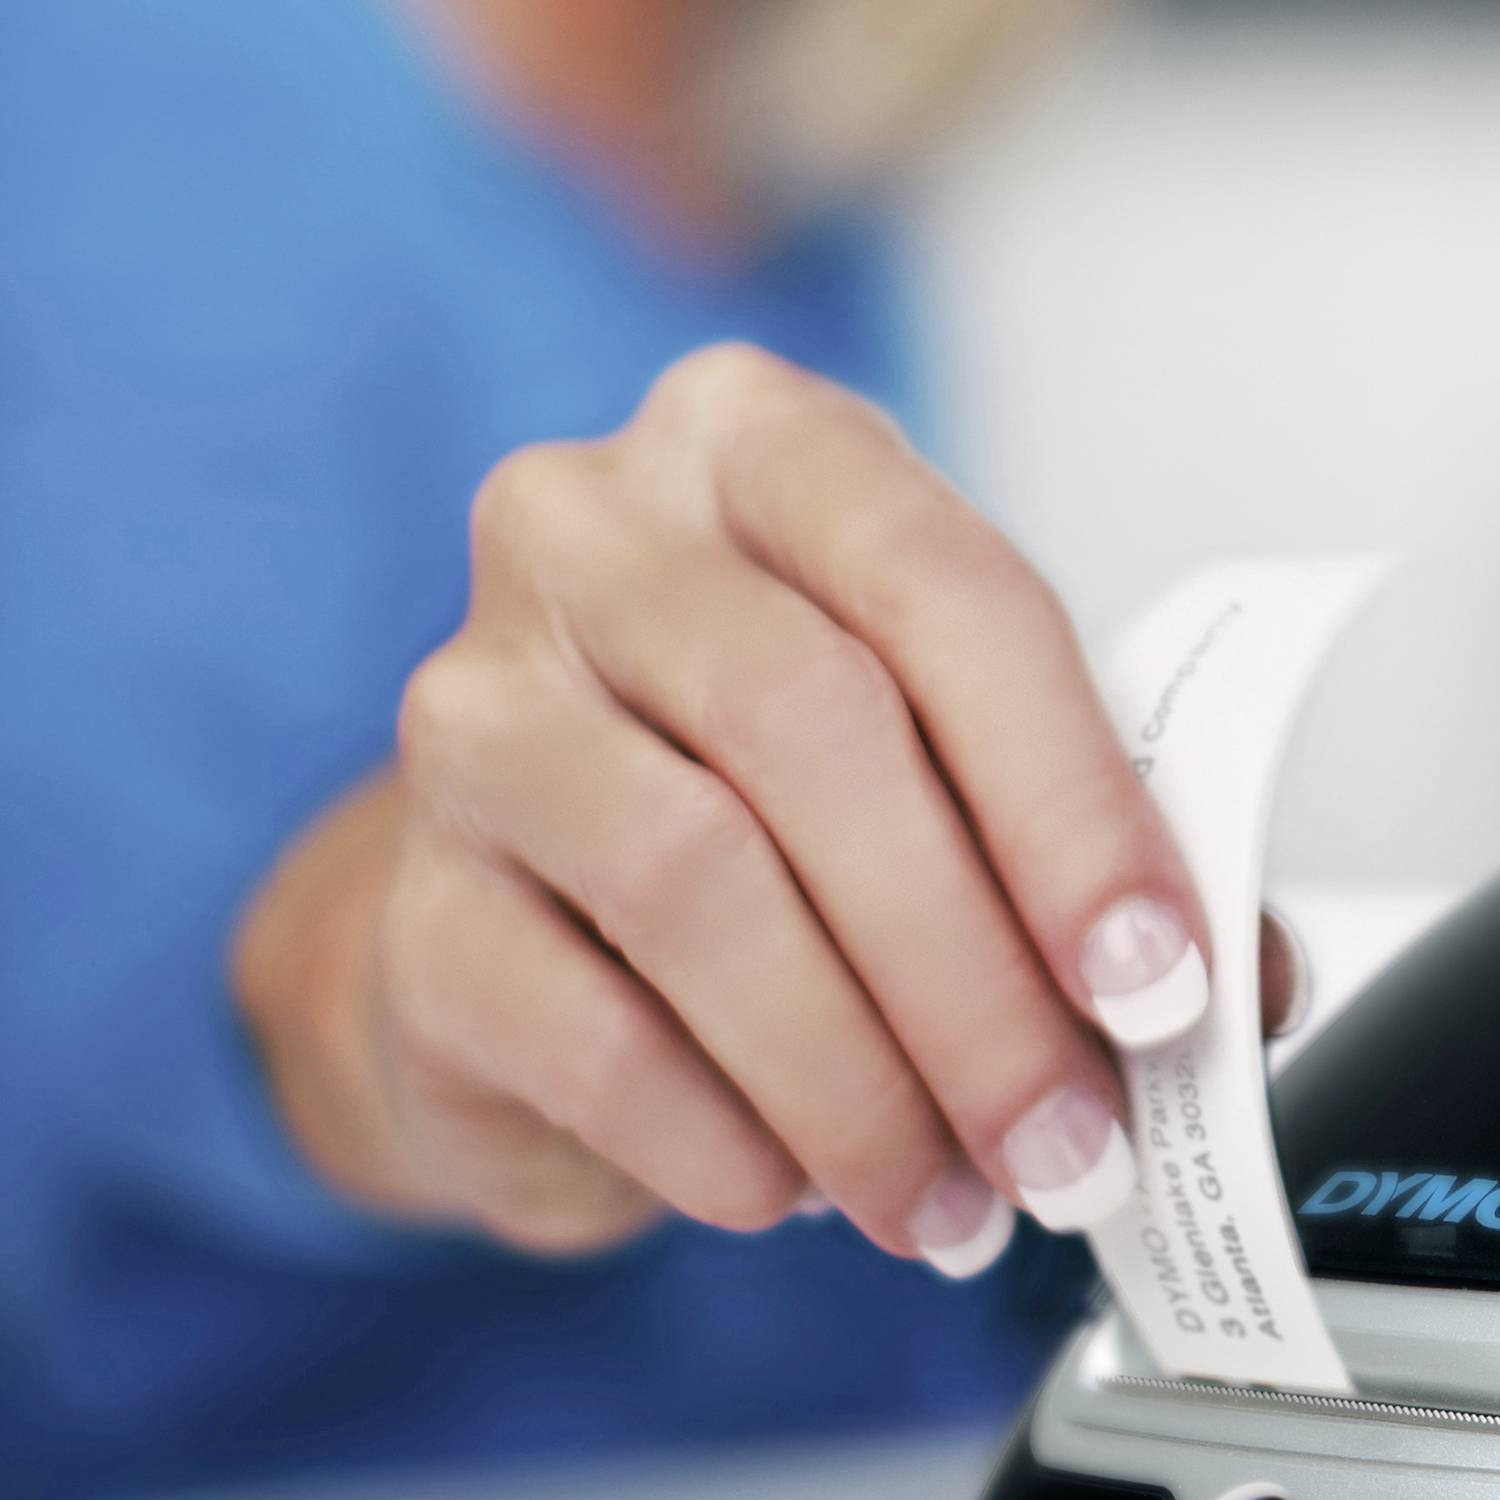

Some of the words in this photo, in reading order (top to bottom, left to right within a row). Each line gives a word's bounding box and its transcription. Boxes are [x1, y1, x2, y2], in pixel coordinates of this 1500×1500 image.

[1193, 1151, 1224, 1202] GA
[1162, 1161, 1231, 1305] Glenlake
[1141, 1226, 1206, 1334] DYMO
[1219, 1316, 1247, 1339] 3
